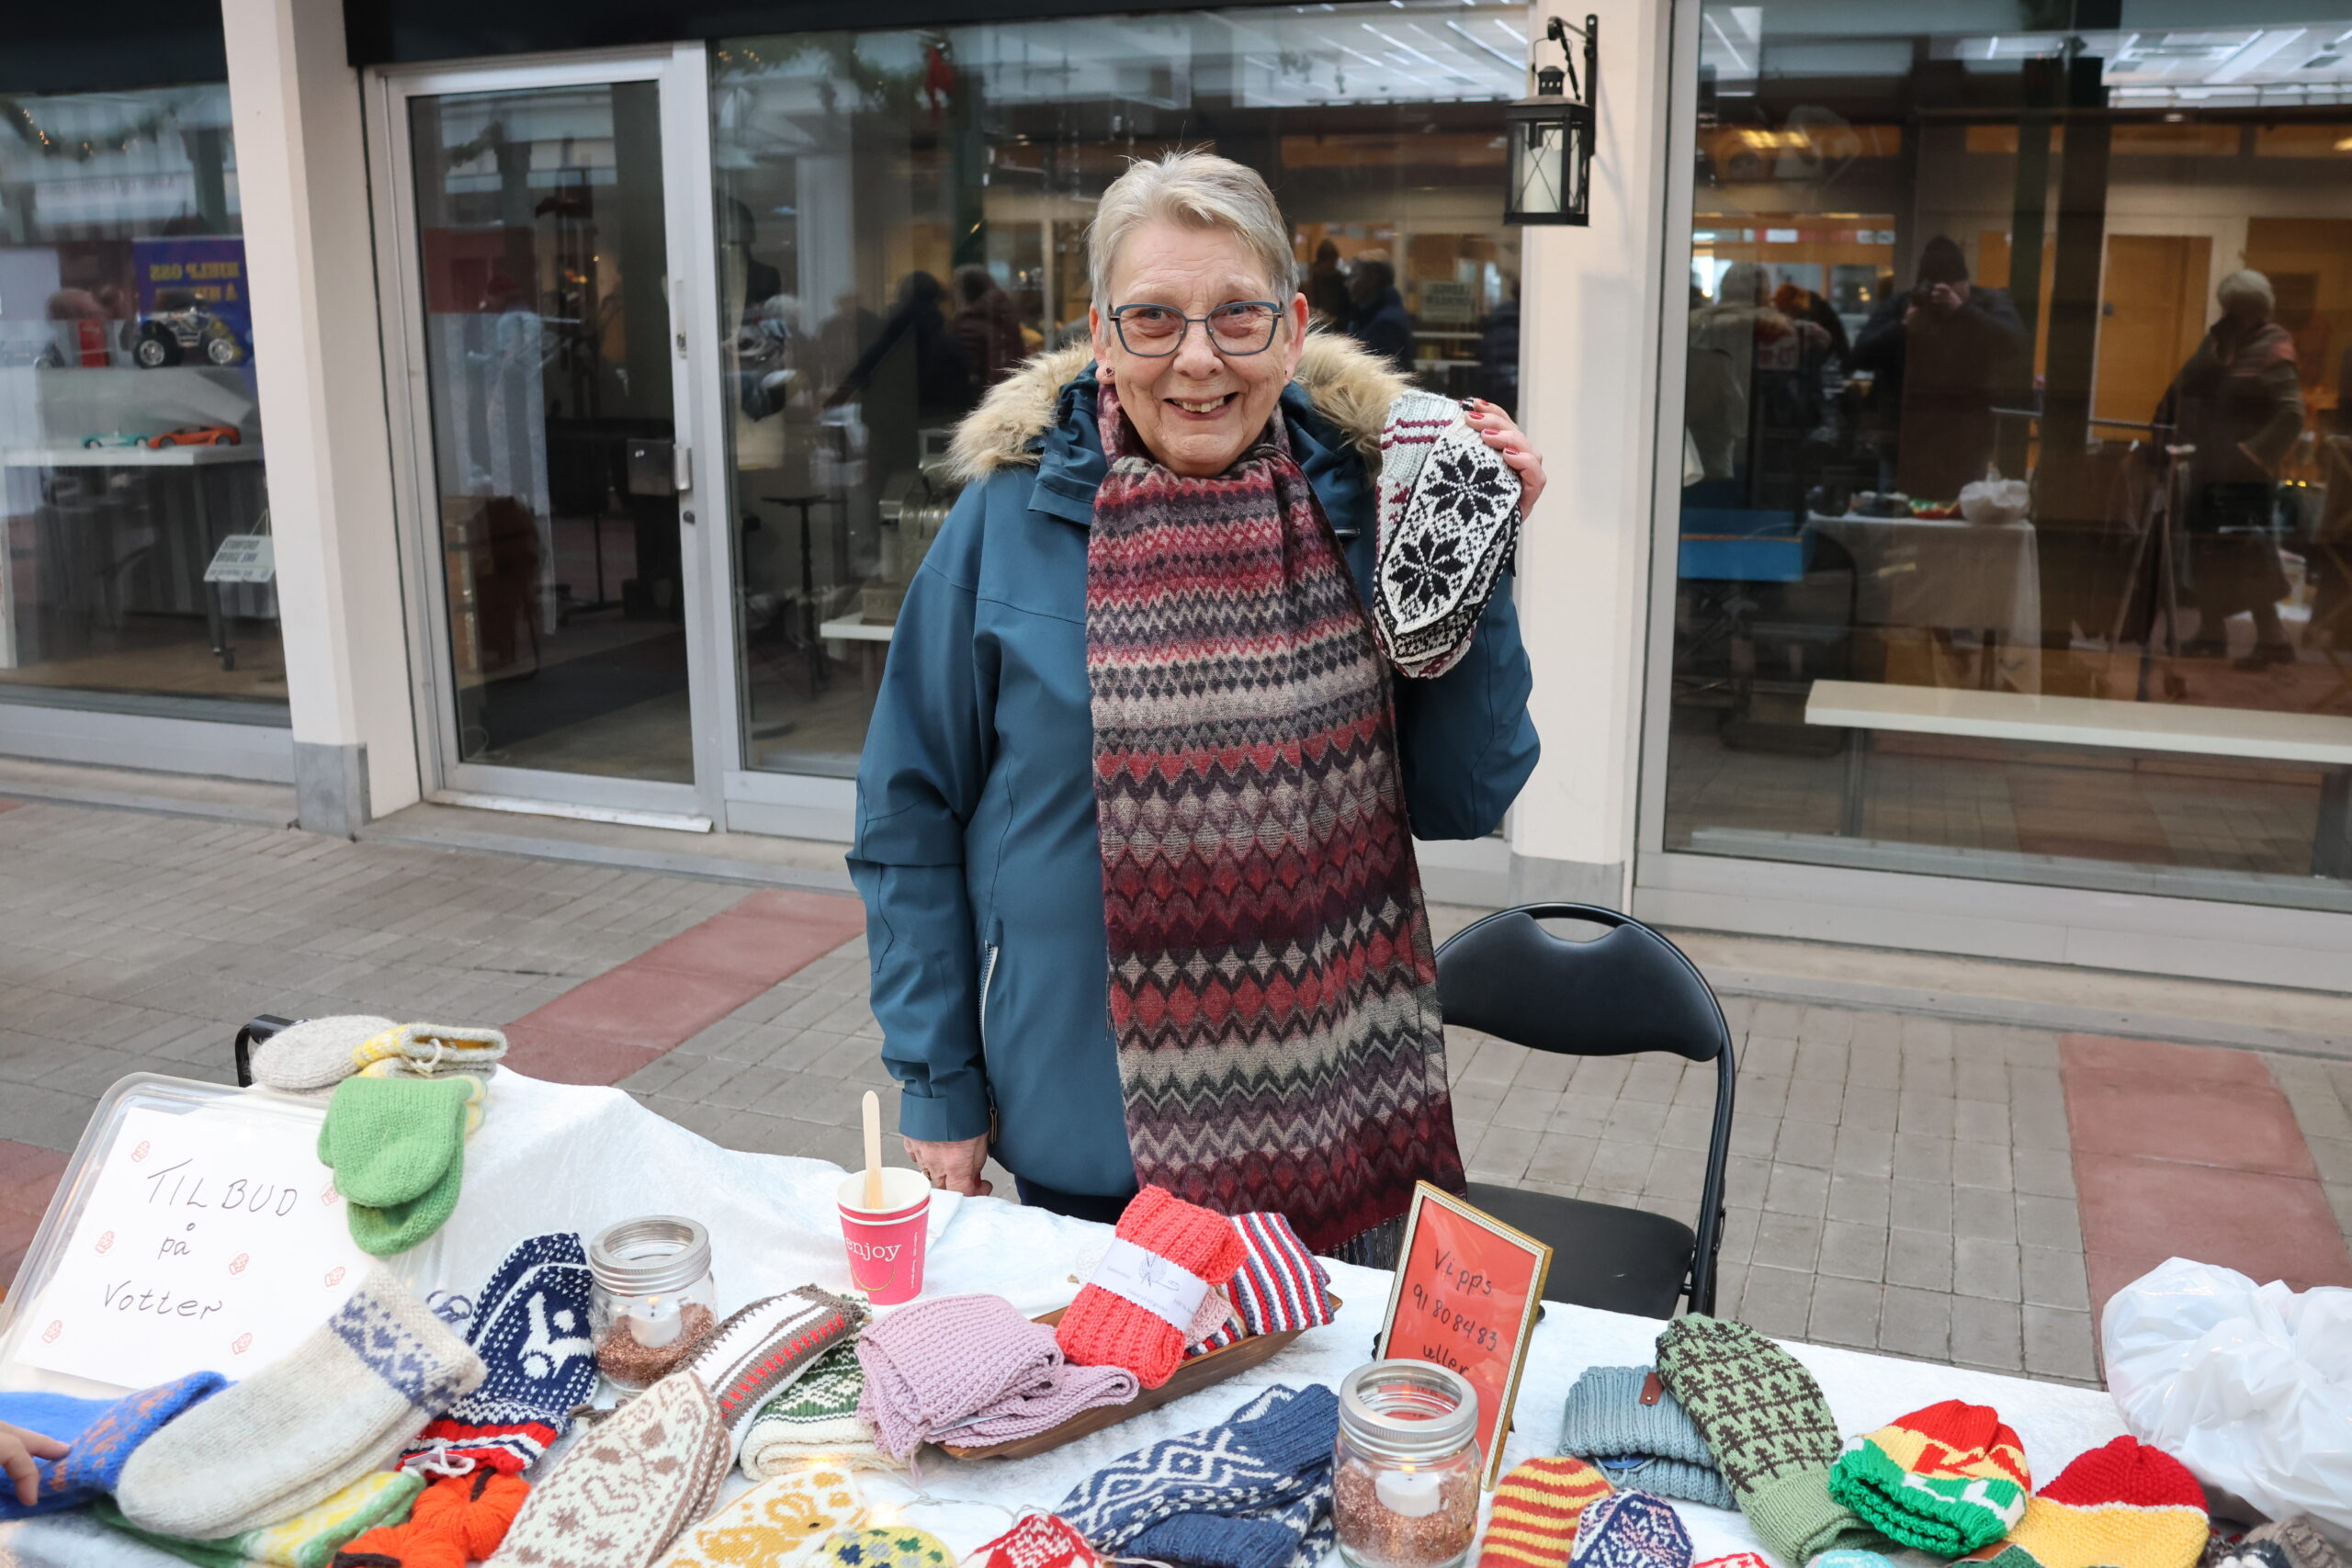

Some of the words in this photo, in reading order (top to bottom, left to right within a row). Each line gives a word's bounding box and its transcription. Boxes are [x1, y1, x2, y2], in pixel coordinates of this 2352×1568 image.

[147, 1158, 299, 1216] TILBUD
[157, 1223, 197, 1259] på
[845, 1237, 902, 1262] enjoy
[1435, 1248, 1493, 1295] Vipps
[104, 1280, 222, 1320] Votter
